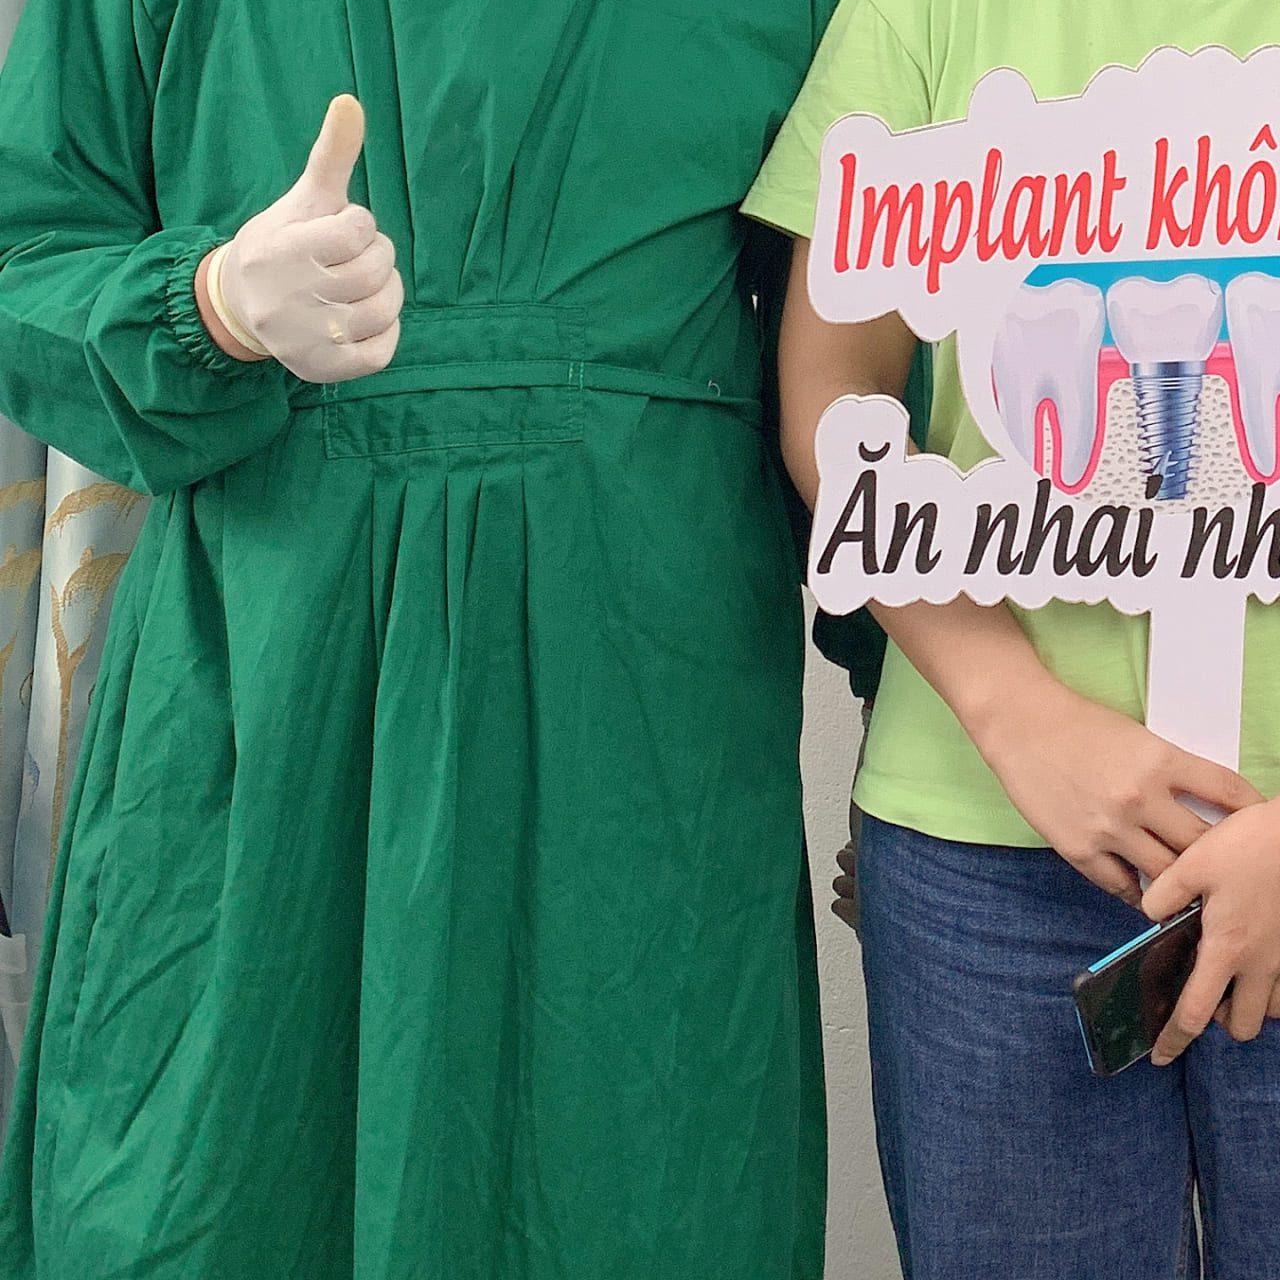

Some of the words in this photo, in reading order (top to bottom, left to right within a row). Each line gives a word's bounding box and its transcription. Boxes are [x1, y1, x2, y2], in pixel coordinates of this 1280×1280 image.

[834, 148, 1127, 294] Implant
[816, 441, 941, 575] Ăn
[963, 473, 1164, 579] nhai
